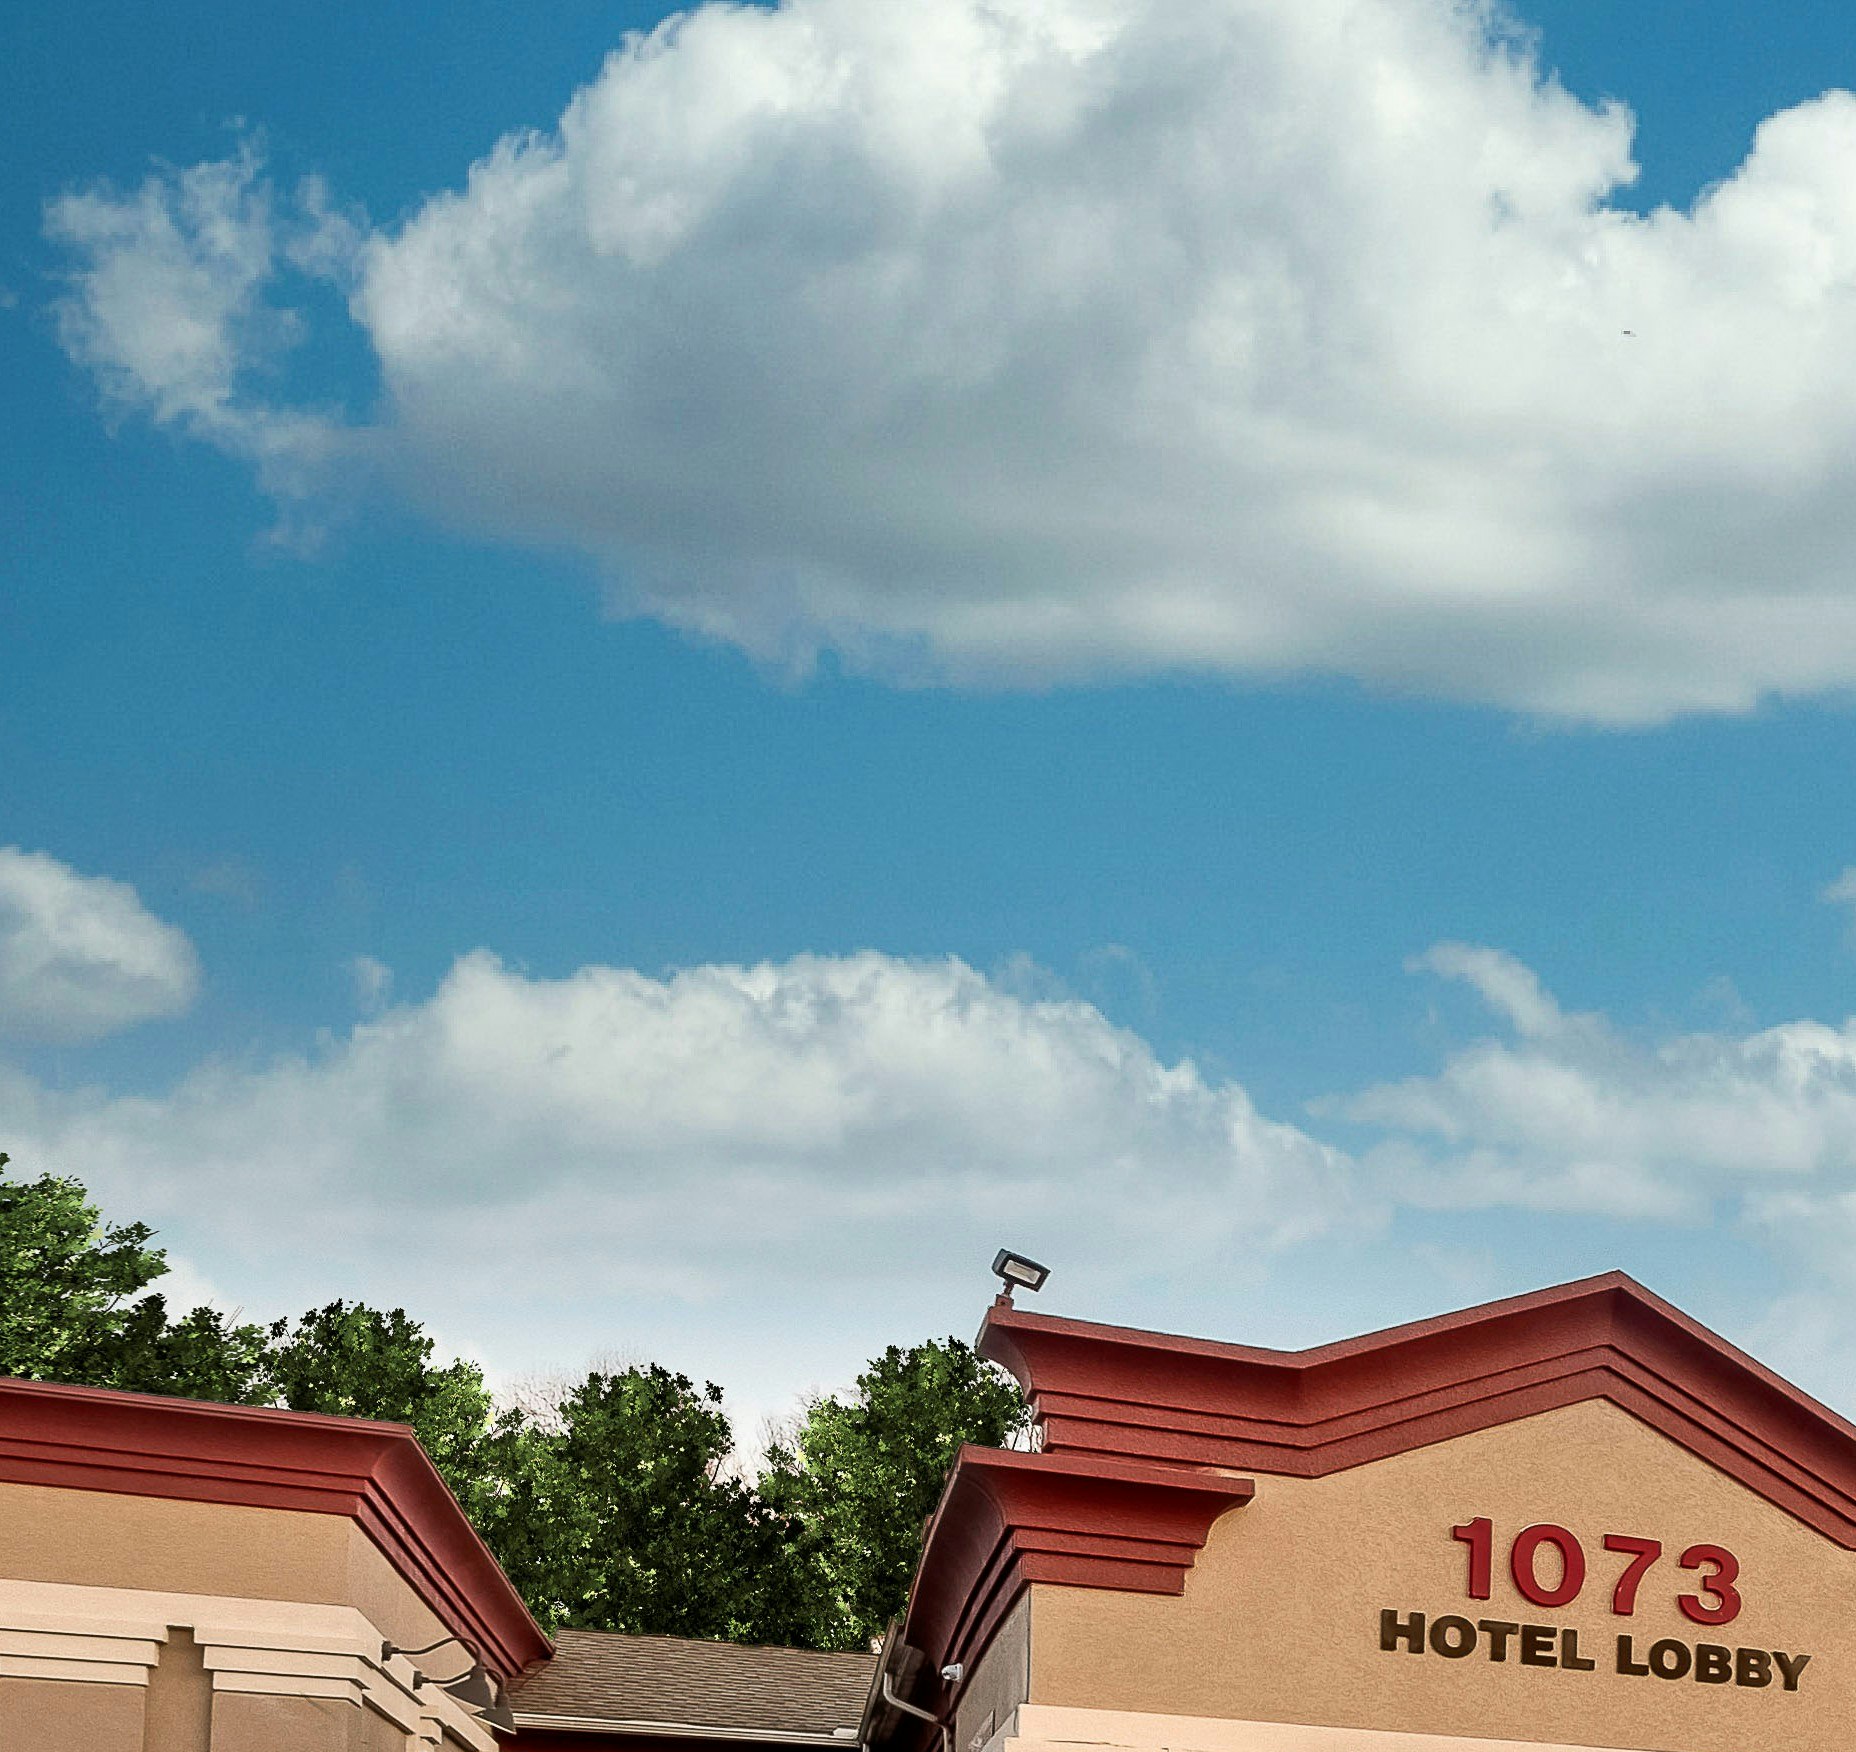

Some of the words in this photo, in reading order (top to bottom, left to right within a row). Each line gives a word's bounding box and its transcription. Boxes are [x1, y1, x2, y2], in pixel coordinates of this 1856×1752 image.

[1452, 1516, 1742, 1626] 1073
[1380, 1608, 1596, 1672] HOTEL
[1616, 1633, 1812, 1692] LOBBY
